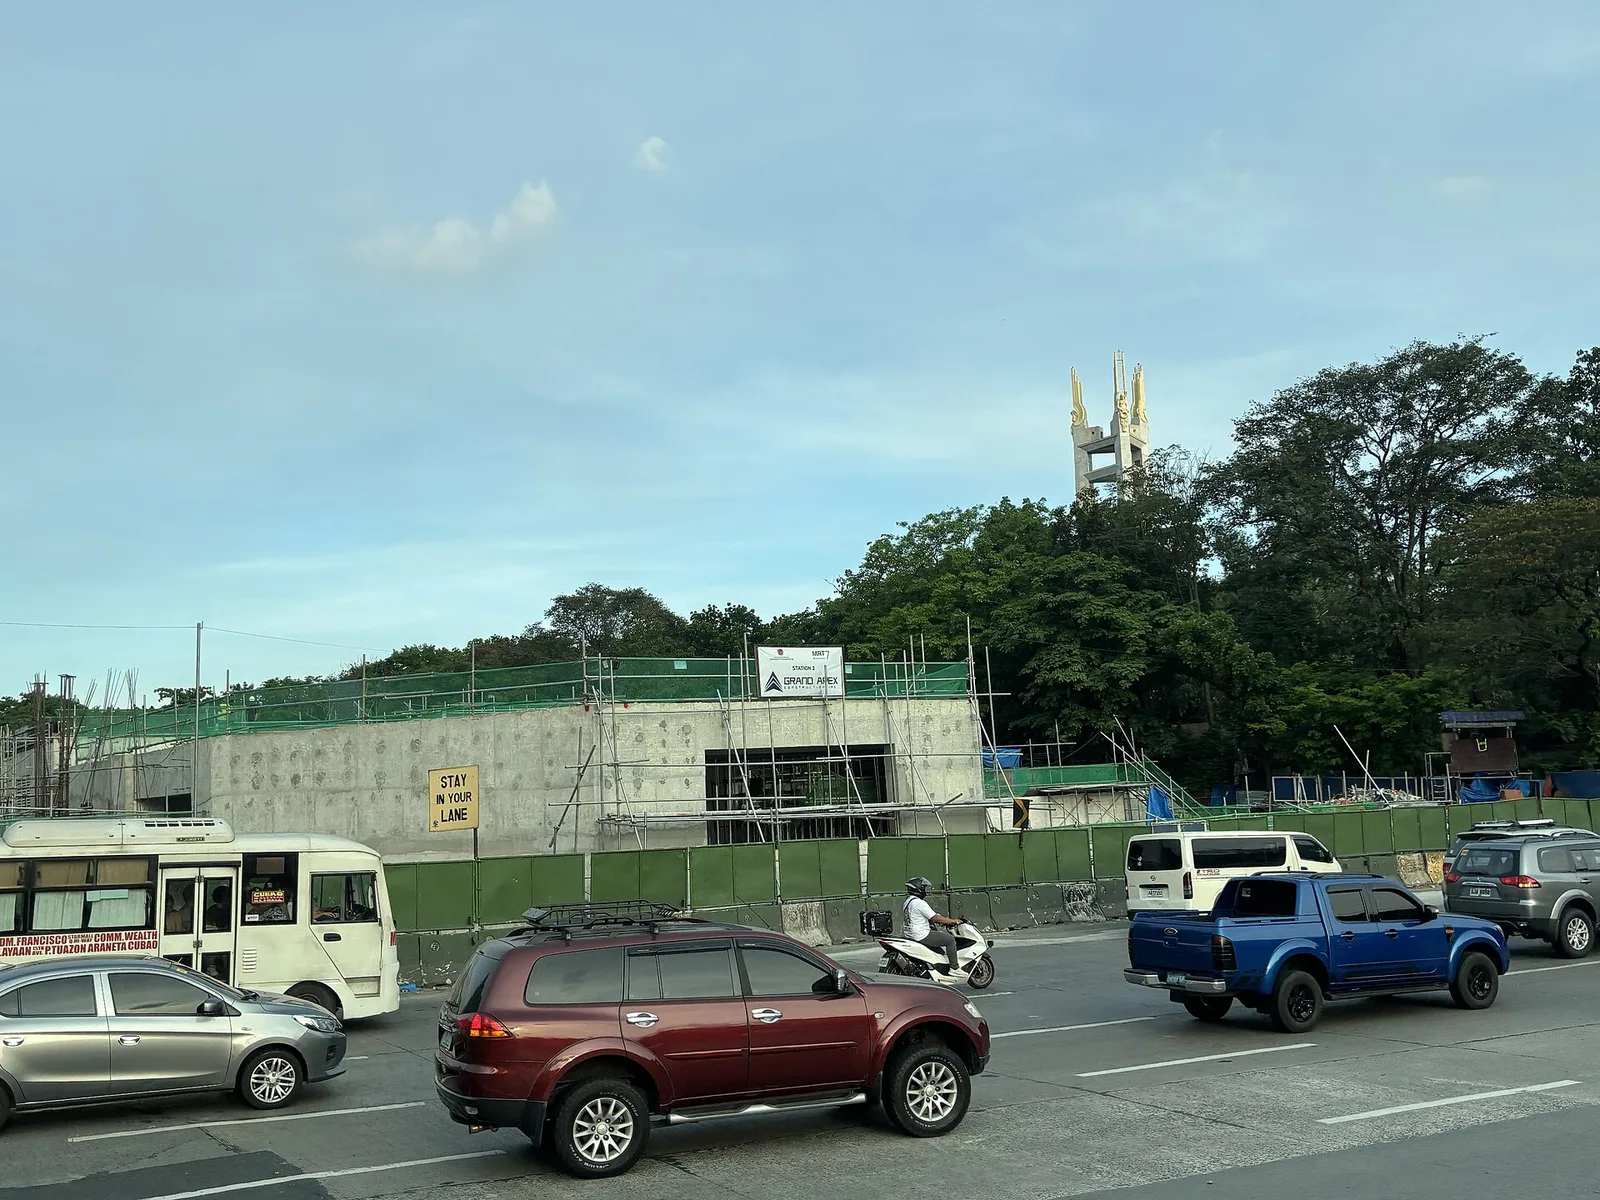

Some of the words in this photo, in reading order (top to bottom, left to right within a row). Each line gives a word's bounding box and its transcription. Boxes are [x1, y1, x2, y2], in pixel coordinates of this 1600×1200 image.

[784, 677, 813, 685] GRAND
[440, 773, 467, 789] STAY
[436, 794, 445, 805] IN
[448, 791, 472, 804] YOUR
[441, 807, 467, 823] LANE
[94, 931, 158, 942] COMM.WEALTH
[45, 944, 86, 956] P.TUAZON
[87, 942, 127, 953] ARANETA
[128, 940, 158, 951] CUBAO
